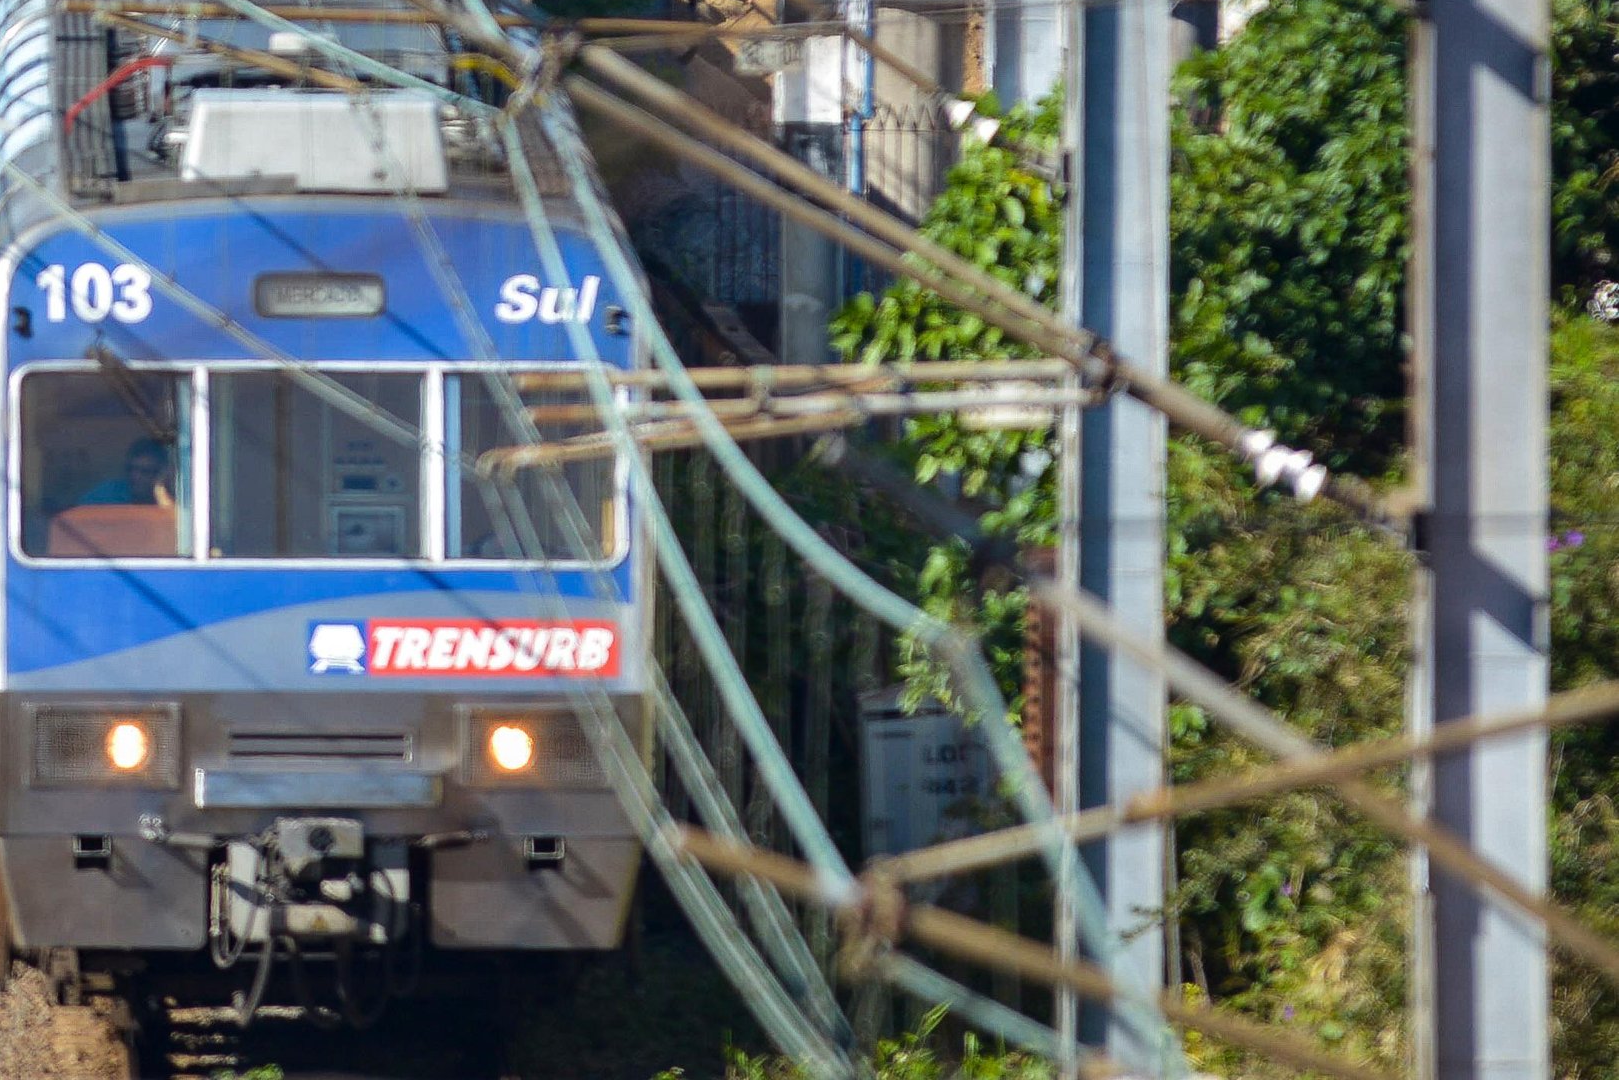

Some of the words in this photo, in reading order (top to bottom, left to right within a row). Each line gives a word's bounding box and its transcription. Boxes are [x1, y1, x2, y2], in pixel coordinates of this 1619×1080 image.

[36, 262, 154, 323] 103
[495, 273, 601, 324] Sul
[373, 626, 614, 670] TRENSURB
